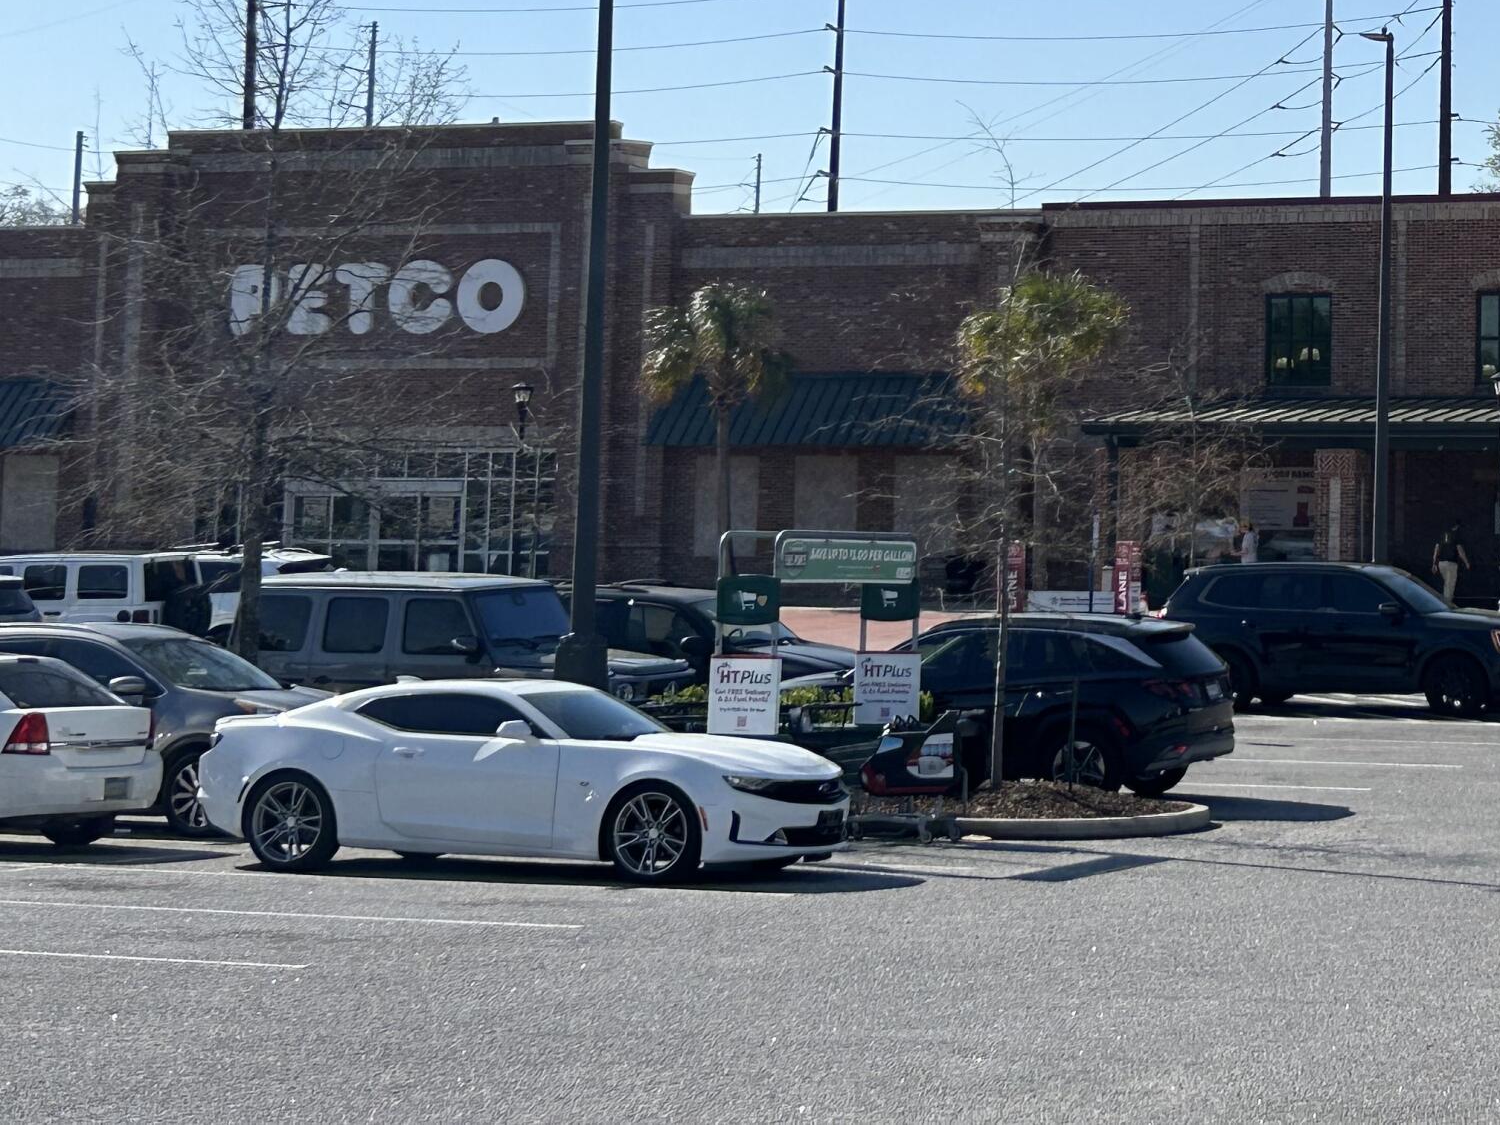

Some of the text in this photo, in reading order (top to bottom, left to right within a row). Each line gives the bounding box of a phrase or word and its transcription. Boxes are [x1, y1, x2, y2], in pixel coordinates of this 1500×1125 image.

[229, 258, 525, 336] PETCO
[1007, 570, 1018, 609] LANE
[1118, 571, 1128, 611] LANE
